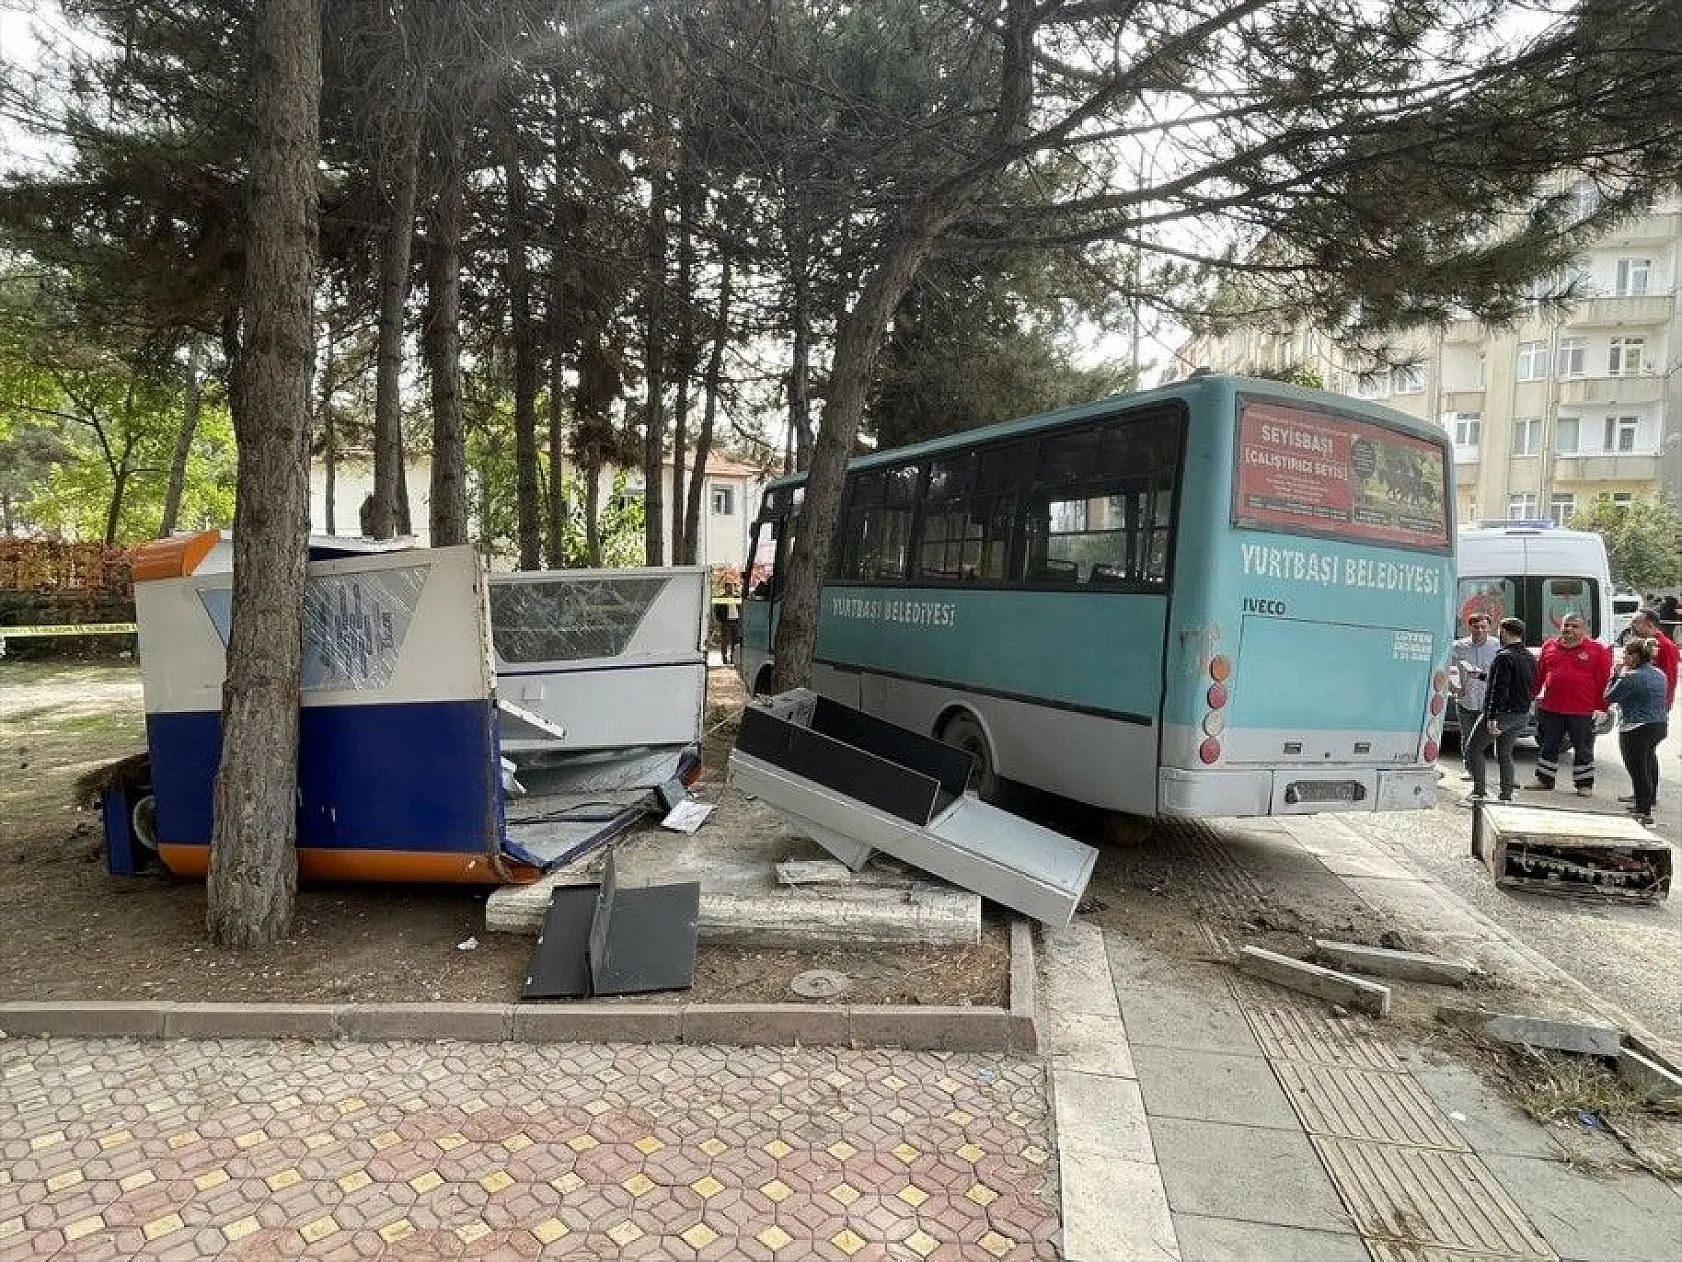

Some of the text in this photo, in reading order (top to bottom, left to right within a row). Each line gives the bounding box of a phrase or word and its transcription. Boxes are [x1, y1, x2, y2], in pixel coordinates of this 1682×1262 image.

[1241, 544, 1440, 594] YURTBAŞI BELEDİYESİ
[1243, 597, 1285, 615] IVECO
